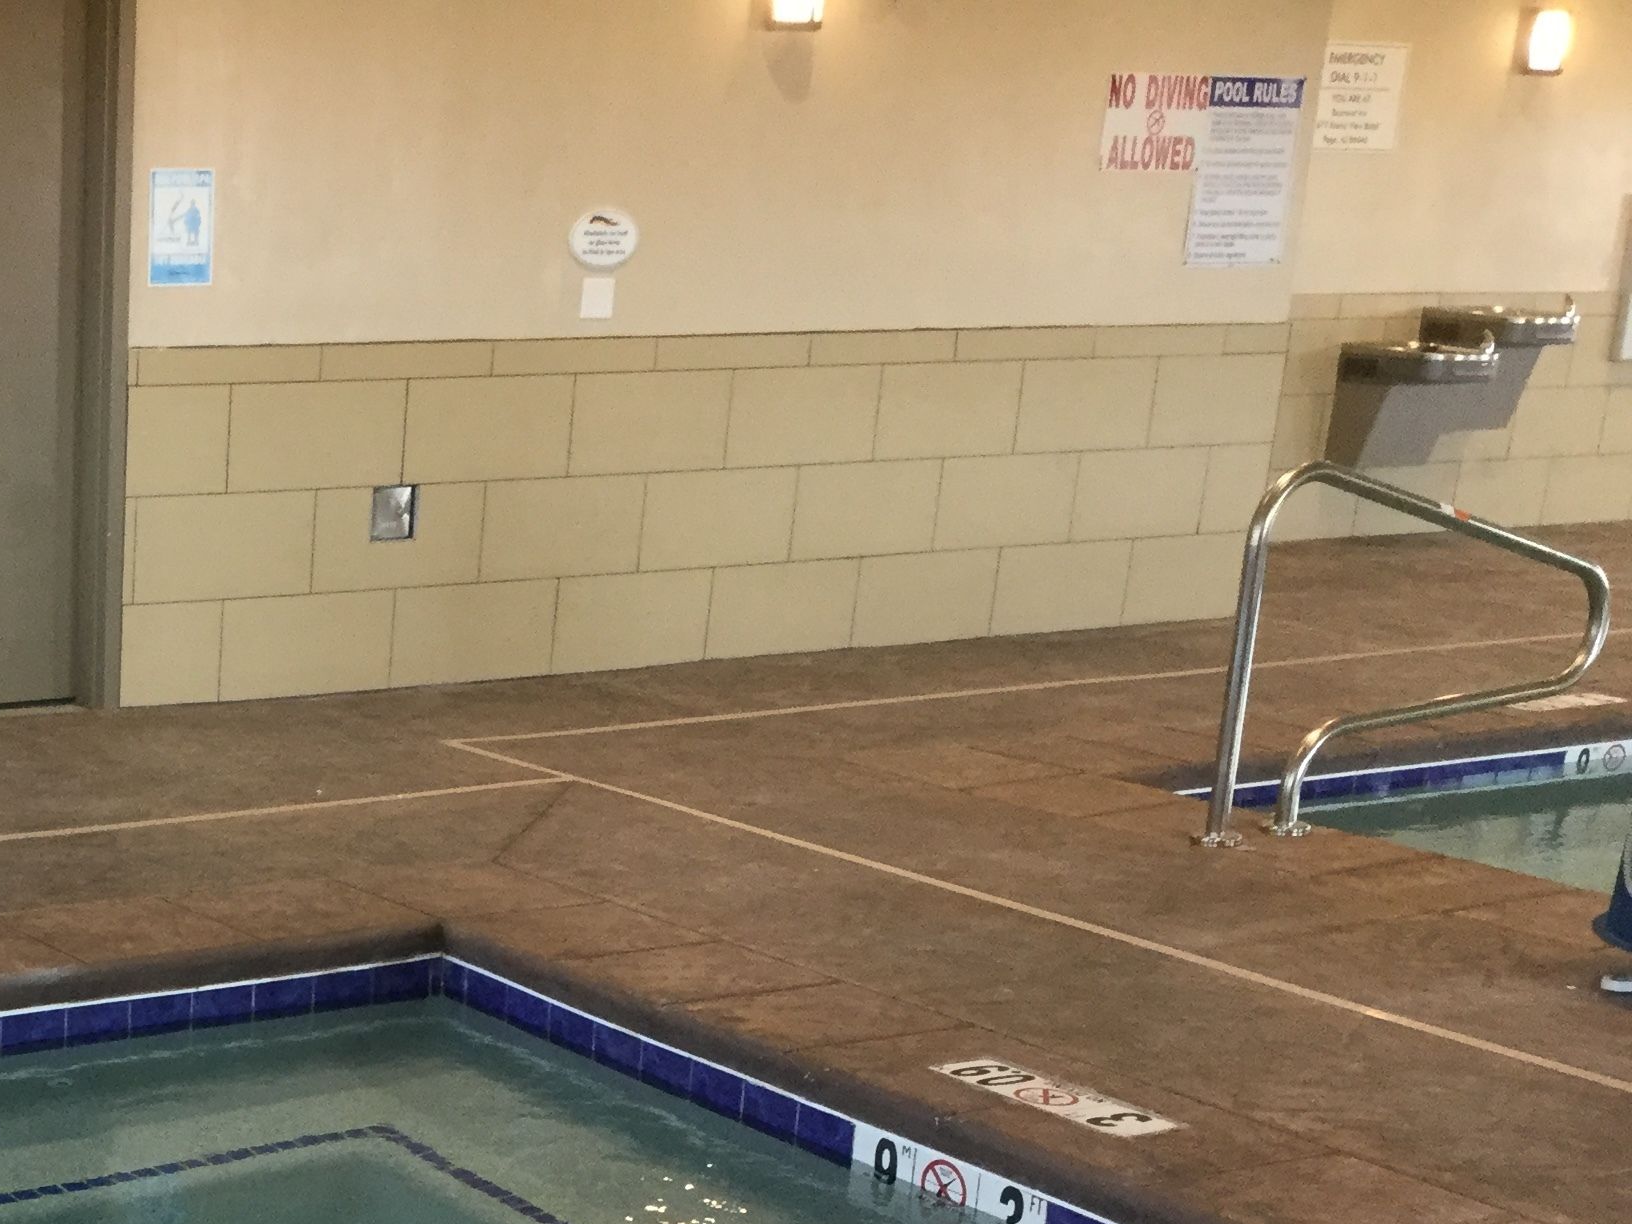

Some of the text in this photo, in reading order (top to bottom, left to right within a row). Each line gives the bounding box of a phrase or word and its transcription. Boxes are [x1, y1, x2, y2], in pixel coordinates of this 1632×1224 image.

[1108, 73, 1210, 111] NO DIVING
[1213, 81, 1298, 104] POOL RULES
[1106, 135, 1197, 171] ALLOWED
[1029, 1194, 1044, 1216] FT
